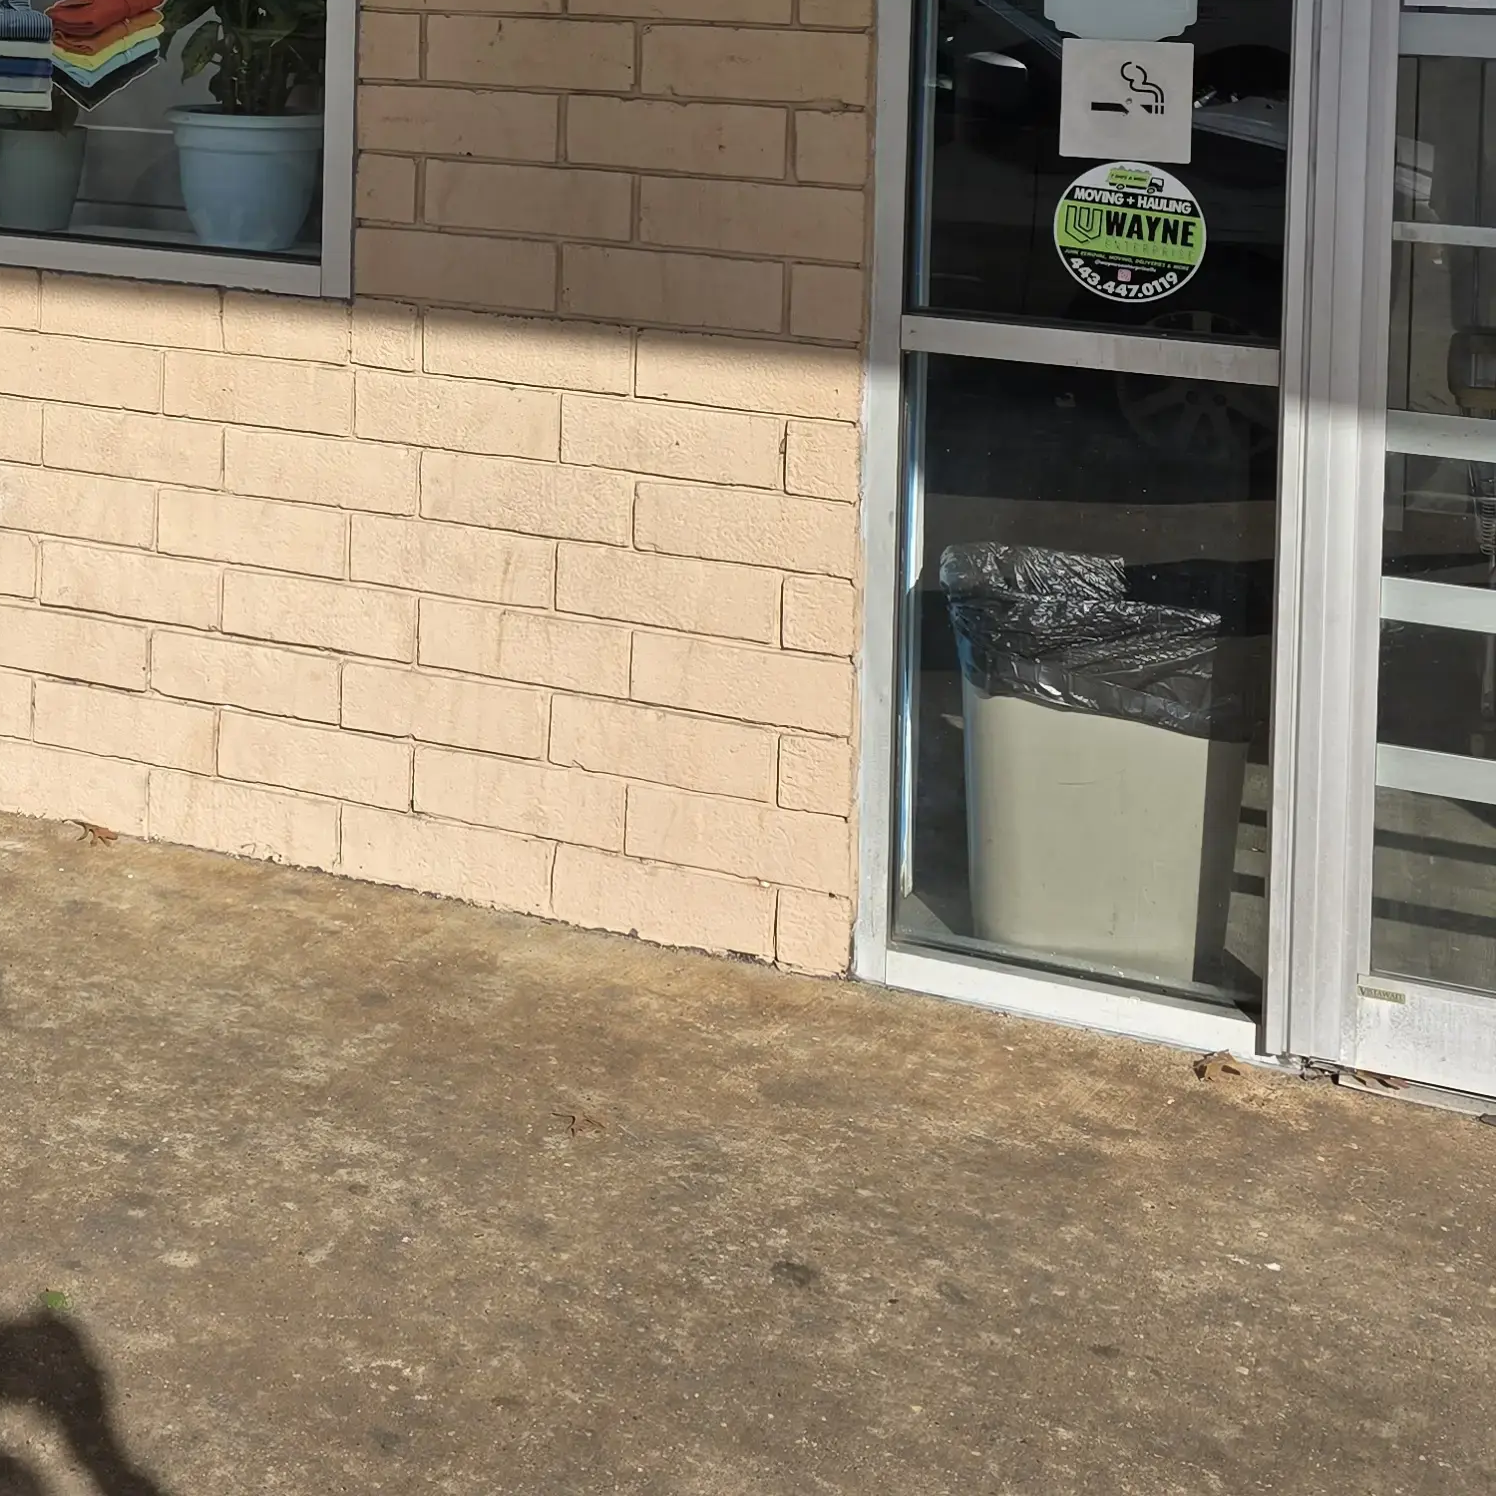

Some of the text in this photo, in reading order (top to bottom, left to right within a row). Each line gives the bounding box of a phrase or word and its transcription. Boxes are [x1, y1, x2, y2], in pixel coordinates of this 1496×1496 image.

[1073, 187, 1125, 206] MOVING
[1137, 195, 1192, 214] HAULING
[1105, 210, 1196, 247] WAYNE
[1070, 257, 1179, 298] 443.447.0119
